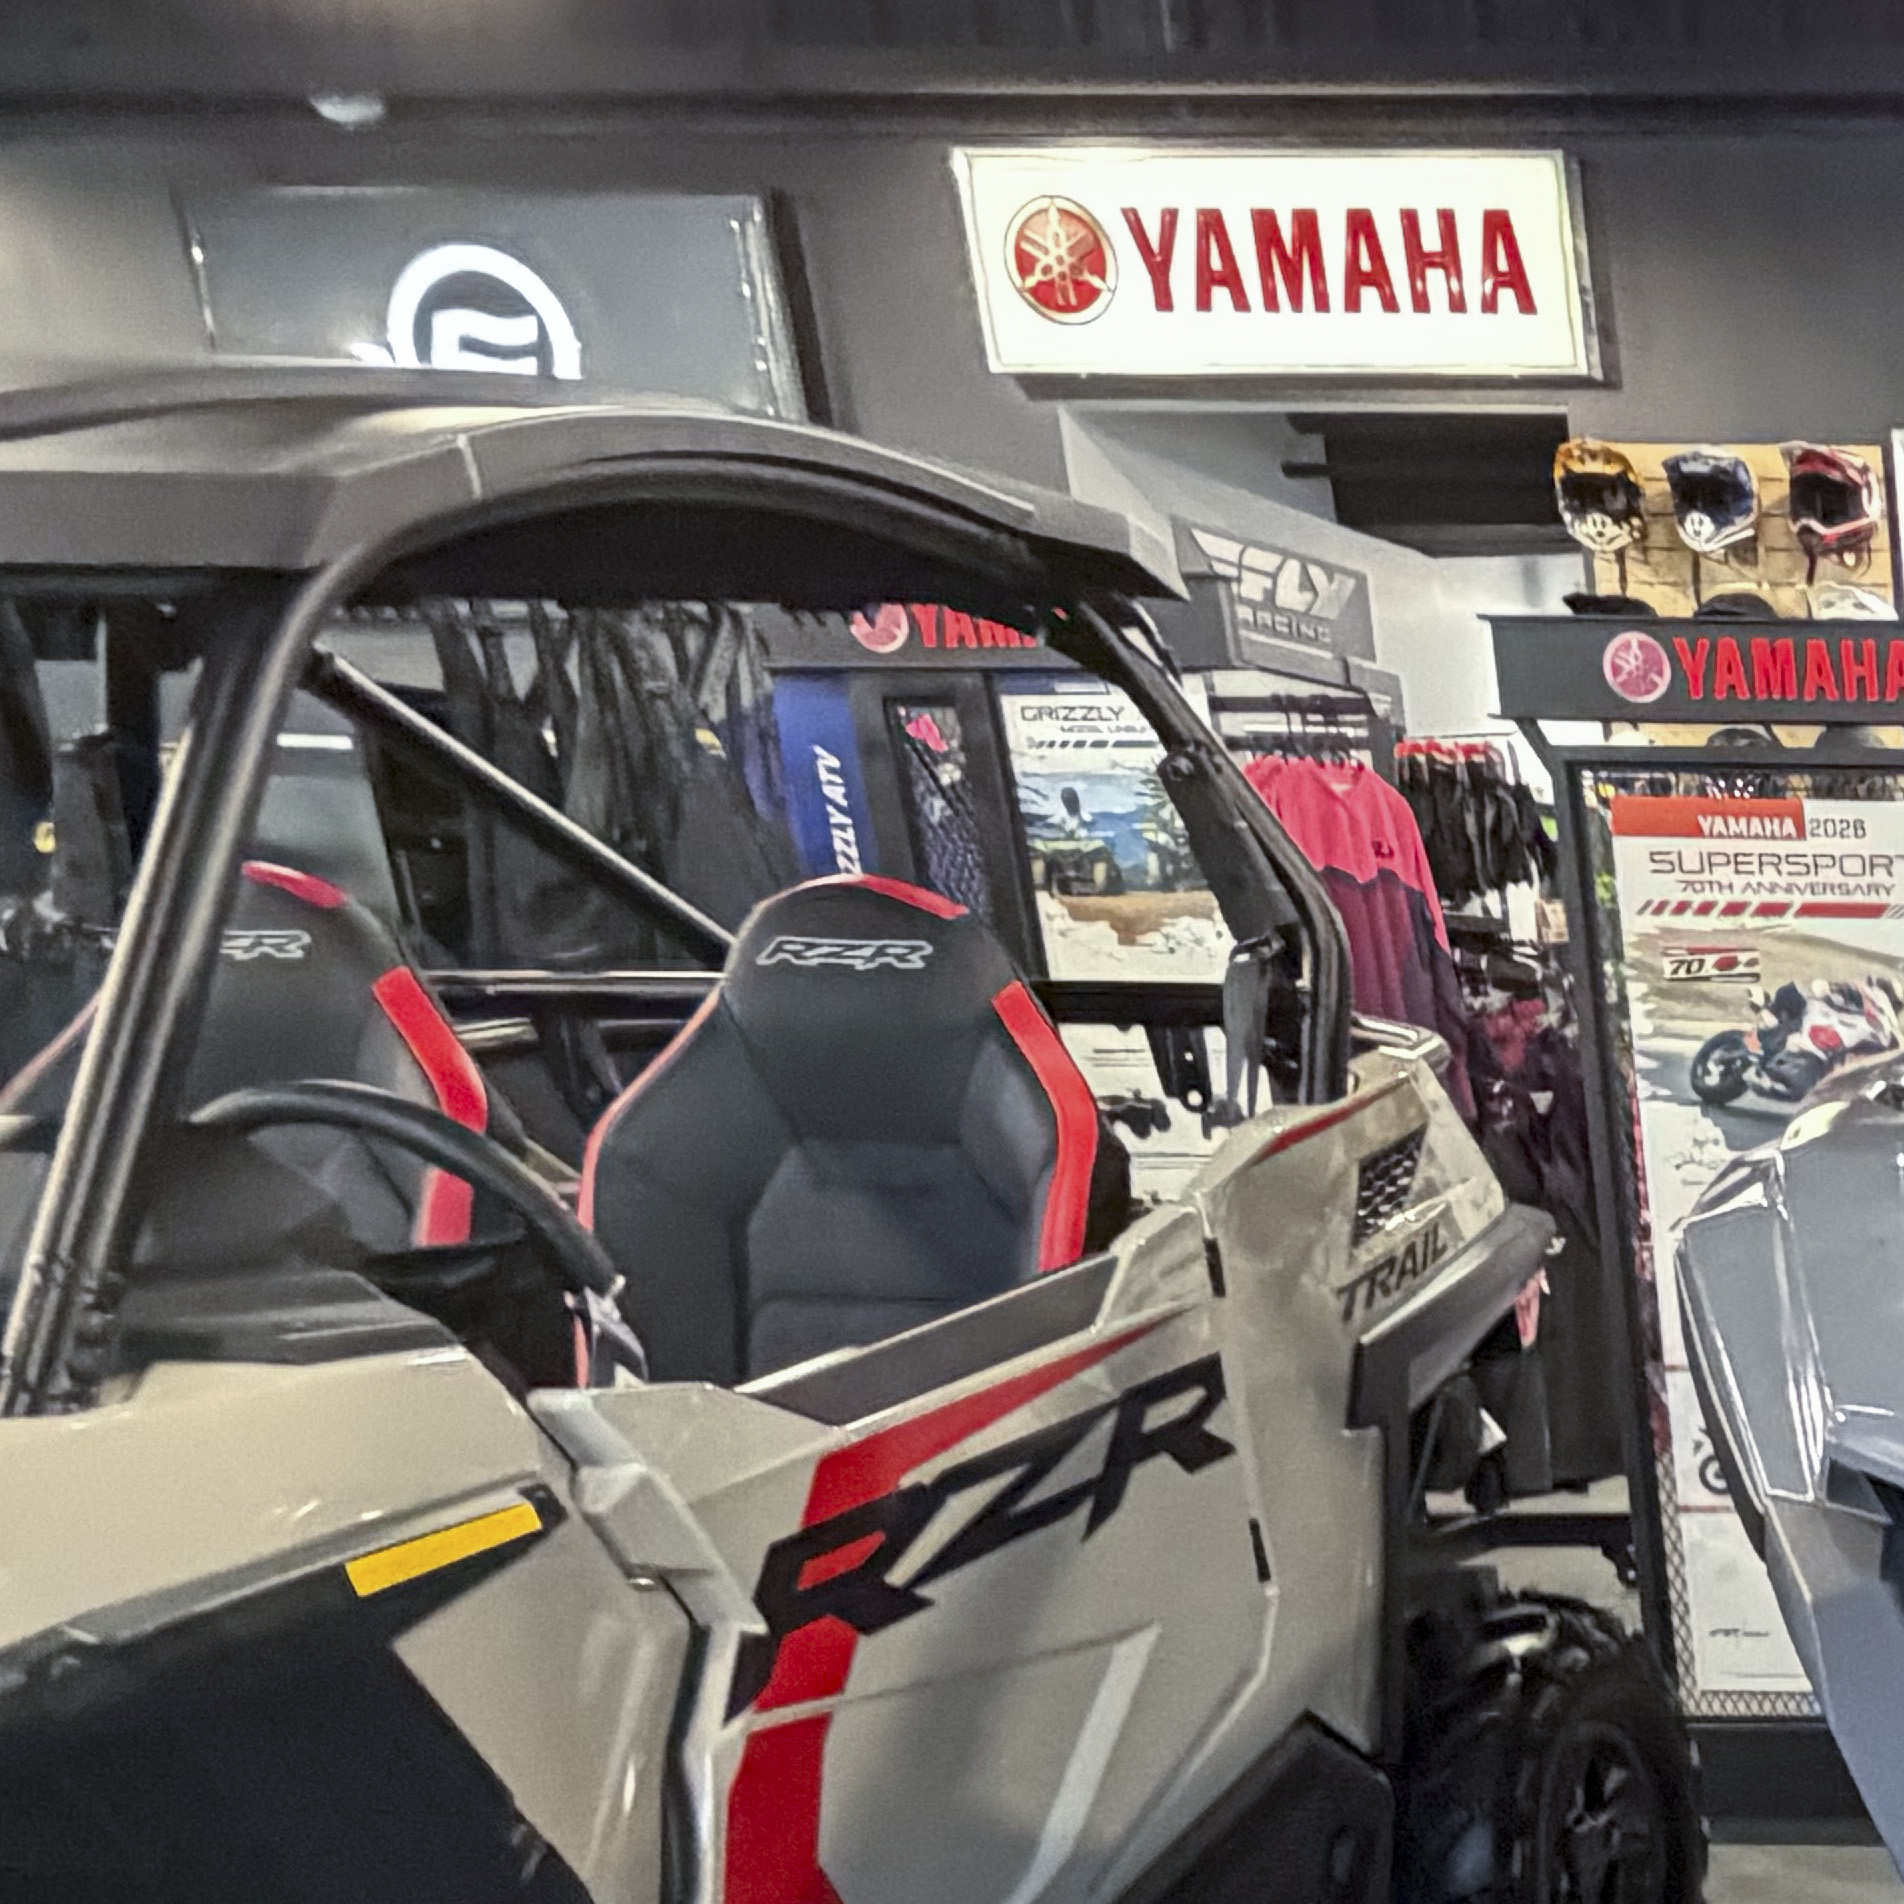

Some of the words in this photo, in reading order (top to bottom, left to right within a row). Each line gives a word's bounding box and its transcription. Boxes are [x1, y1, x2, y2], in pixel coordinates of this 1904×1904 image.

[1119, 207, 1537, 315] YAMAHA
[910, 602, 1038, 648] YAM
[1020, 705, 1126, 722] GRIZZLY
[1696, 815, 1798, 839] YAMAHA
[1675, 880, 1735, 896] 70TH
[1740, 880, 1896, 898] ANNIVERSARY
[756, 935, 934, 970] RZR
[1335, 1220, 1449, 1323] TRAIL
[722, 1351, 1238, 1724] RZR
